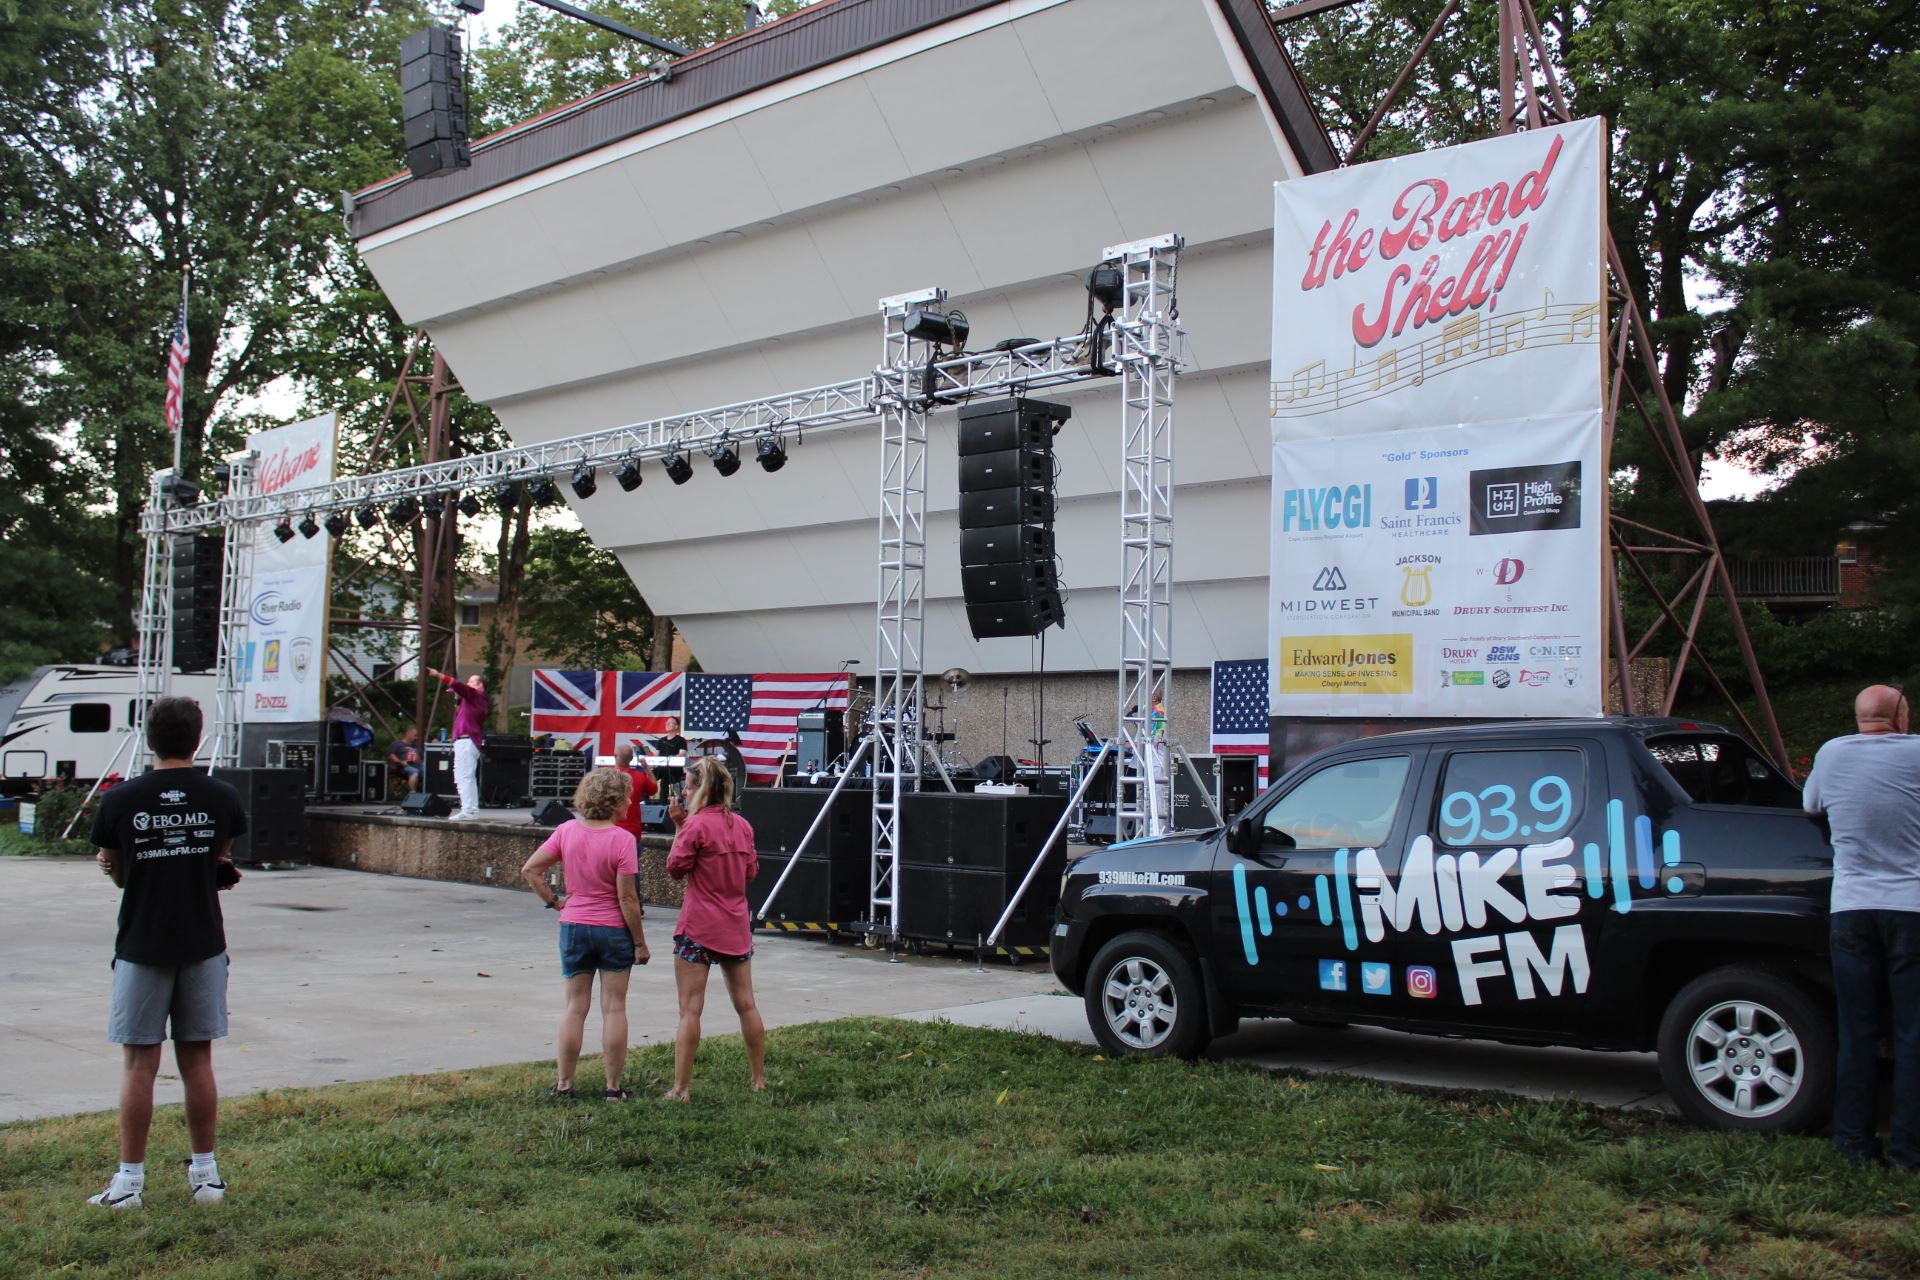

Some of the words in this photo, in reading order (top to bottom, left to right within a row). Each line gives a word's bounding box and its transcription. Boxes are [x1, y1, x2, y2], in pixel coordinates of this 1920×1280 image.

[1301, 208, 1374, 291] the
[1379, 133, 1565, 260] Band
[1352, 222, 1529, 348] Shell!
[1420, 448, 1469, 460] Sponsors
[1524, 481, 1552, 497] High
[1282, 483, 1372, 532] FLYCGI
[1523, 492, 1562, 507] Profile
[1381, 515, 1412, 529] Saint
[1416, 512, 1462, 527] Francis
[1391, 529, 1449, 538] HEALTHCARE
[1395, 554, 1442, 566] JACKSON
[278, 600, 302, 612] Radio
[1280, 597, 1379, 612] MIDWEST
[1453, 606, 1491, 615] DRURY
[1493, 605, 1549, 614] SOUTHWEST
[1292, 648, 1346, 666] Edward
[1348, 648, 1397, 667] Jones
[1442, 647, 1479, 659] DRURY
[1486, 653, 1521, 661] SIGNS
[1491, 646, 1517, 654] DSW
[254, 693, 288, 709] PENZEL
[1440, 775, 1572, 846] 93.9
[151, 813, 182, 828] EBO
[184, 812, 208, 825] MD
[1098, 870, 1186, 886] 939MikeFM.com
[1355, 834, 1581, 943] MIKE
[1450, 923, 1591, 1006] FM
